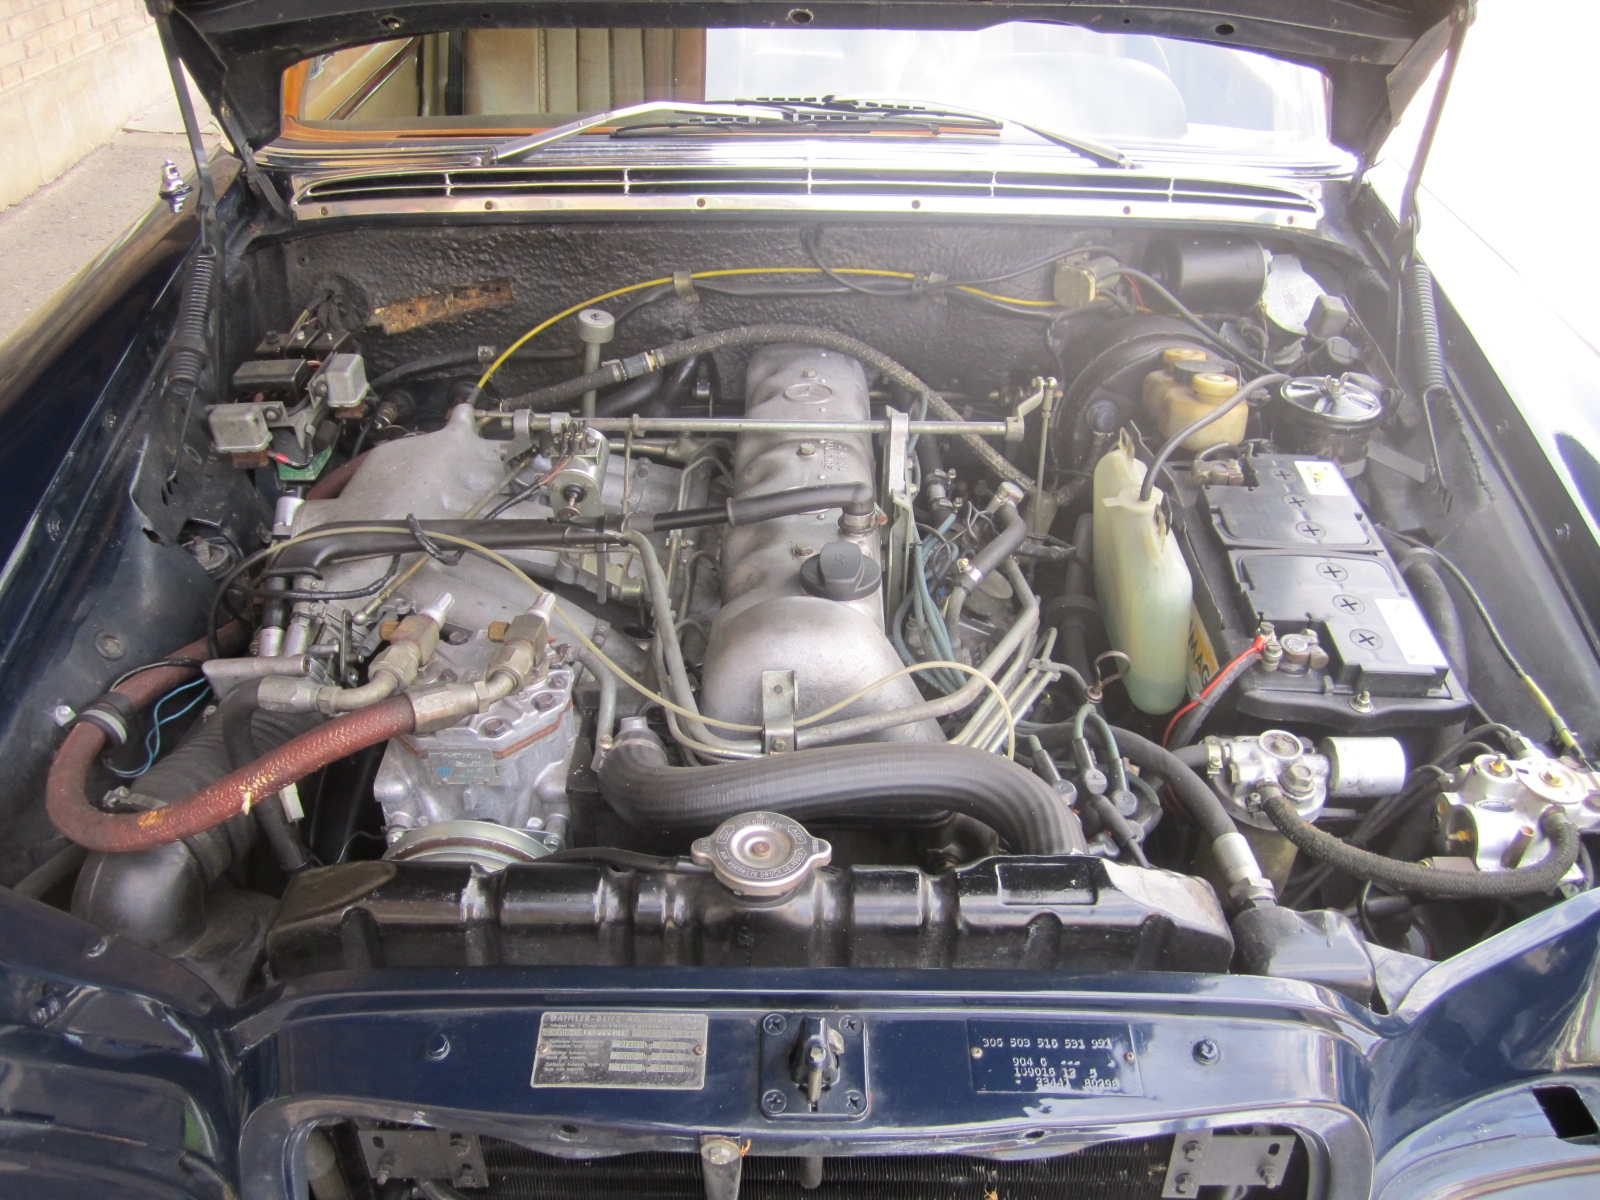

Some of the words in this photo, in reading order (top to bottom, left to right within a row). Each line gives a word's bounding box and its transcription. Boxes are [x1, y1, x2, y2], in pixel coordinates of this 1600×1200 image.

[720, 831, 729, 841] ZU
[792, 828, 804, 843] AUF
[759, 869, 782, 878] DRUCK
[1009, 1038, 1031, 1048] 503
[1037, 1038, 1059, 1049] 516
[1064, 1038, 1086, 1049] 531
[1012, 1057, 1033, 1067] 904
[1013, 1067, 1056, 1078] 109016
